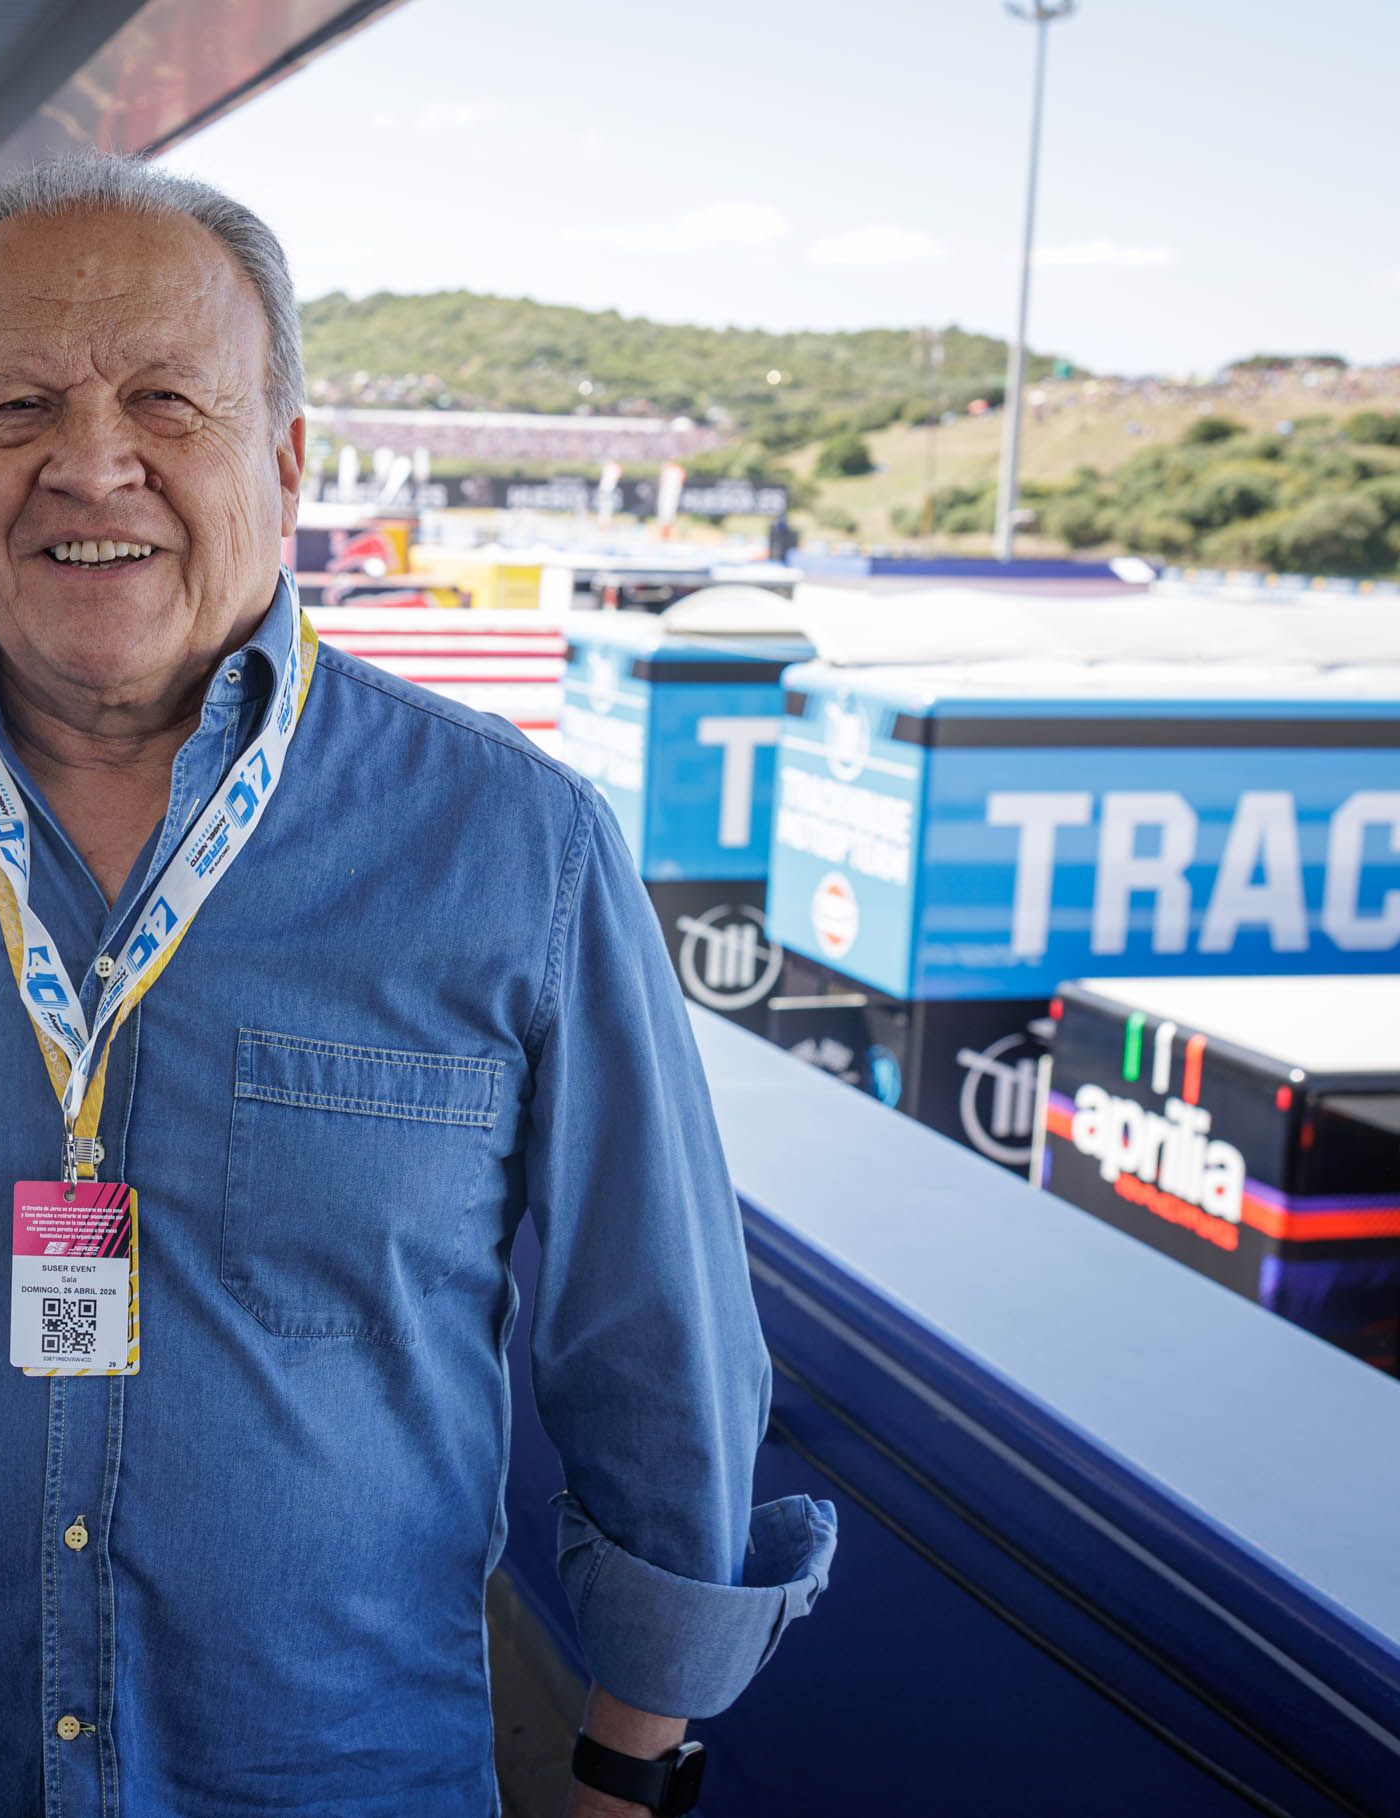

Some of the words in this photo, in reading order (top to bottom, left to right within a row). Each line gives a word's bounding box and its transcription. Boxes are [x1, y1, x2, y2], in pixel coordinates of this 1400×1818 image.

[190, 841, 209, 867] NIETO
[195, 822, 230, 878] JEREZ
[1072, 1083, 1246, 1225] aprilia
[42, 1264, 68, 1272] SUSER
[21, 1286, 61, 1294] DOMINGO,
